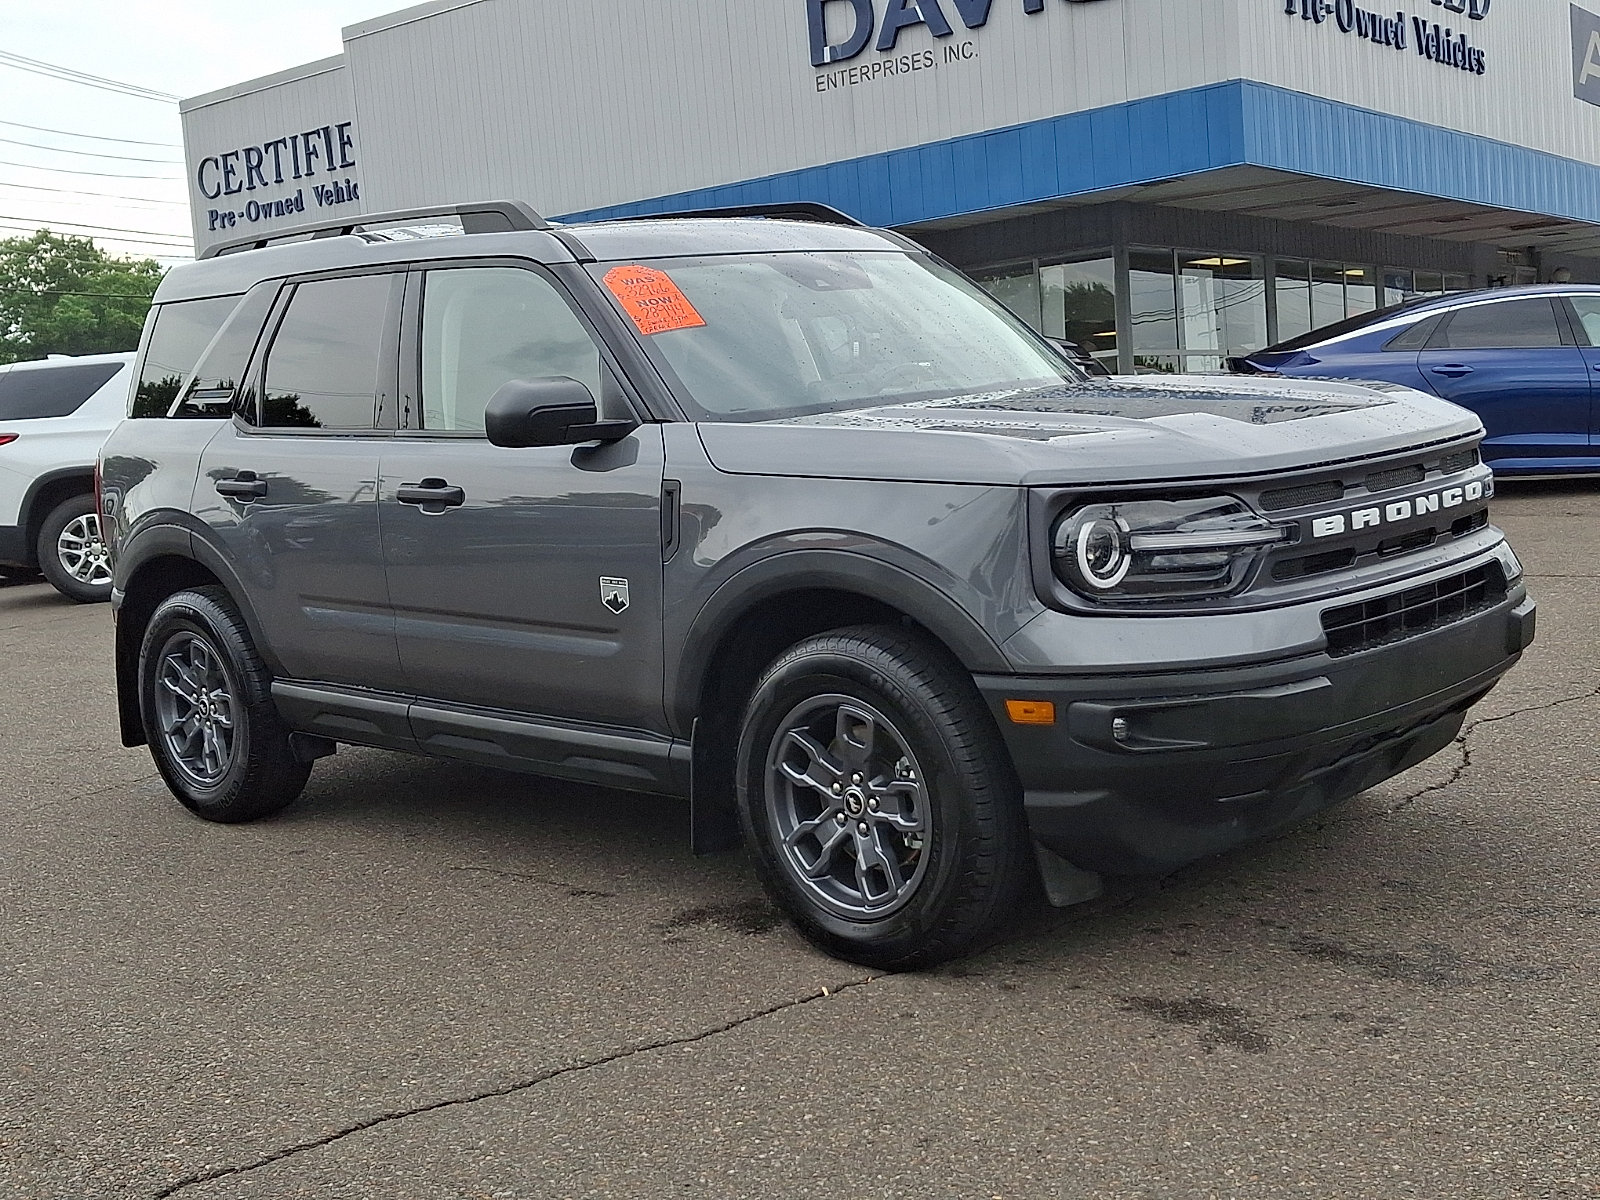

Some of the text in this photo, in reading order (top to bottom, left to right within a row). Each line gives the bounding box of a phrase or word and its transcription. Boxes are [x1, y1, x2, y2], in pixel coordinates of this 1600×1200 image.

[815, 41, 979, 92] ENTERPRISES, INC.
[1412, 16, 1486, 75] Vehicles
[207, 189, 305, 231] Pre-Owned
[621, 276, 655, 285] WAS
[635, 296, 673, 307] NOW
[1312, 481, 1483, 538] BRONCO
